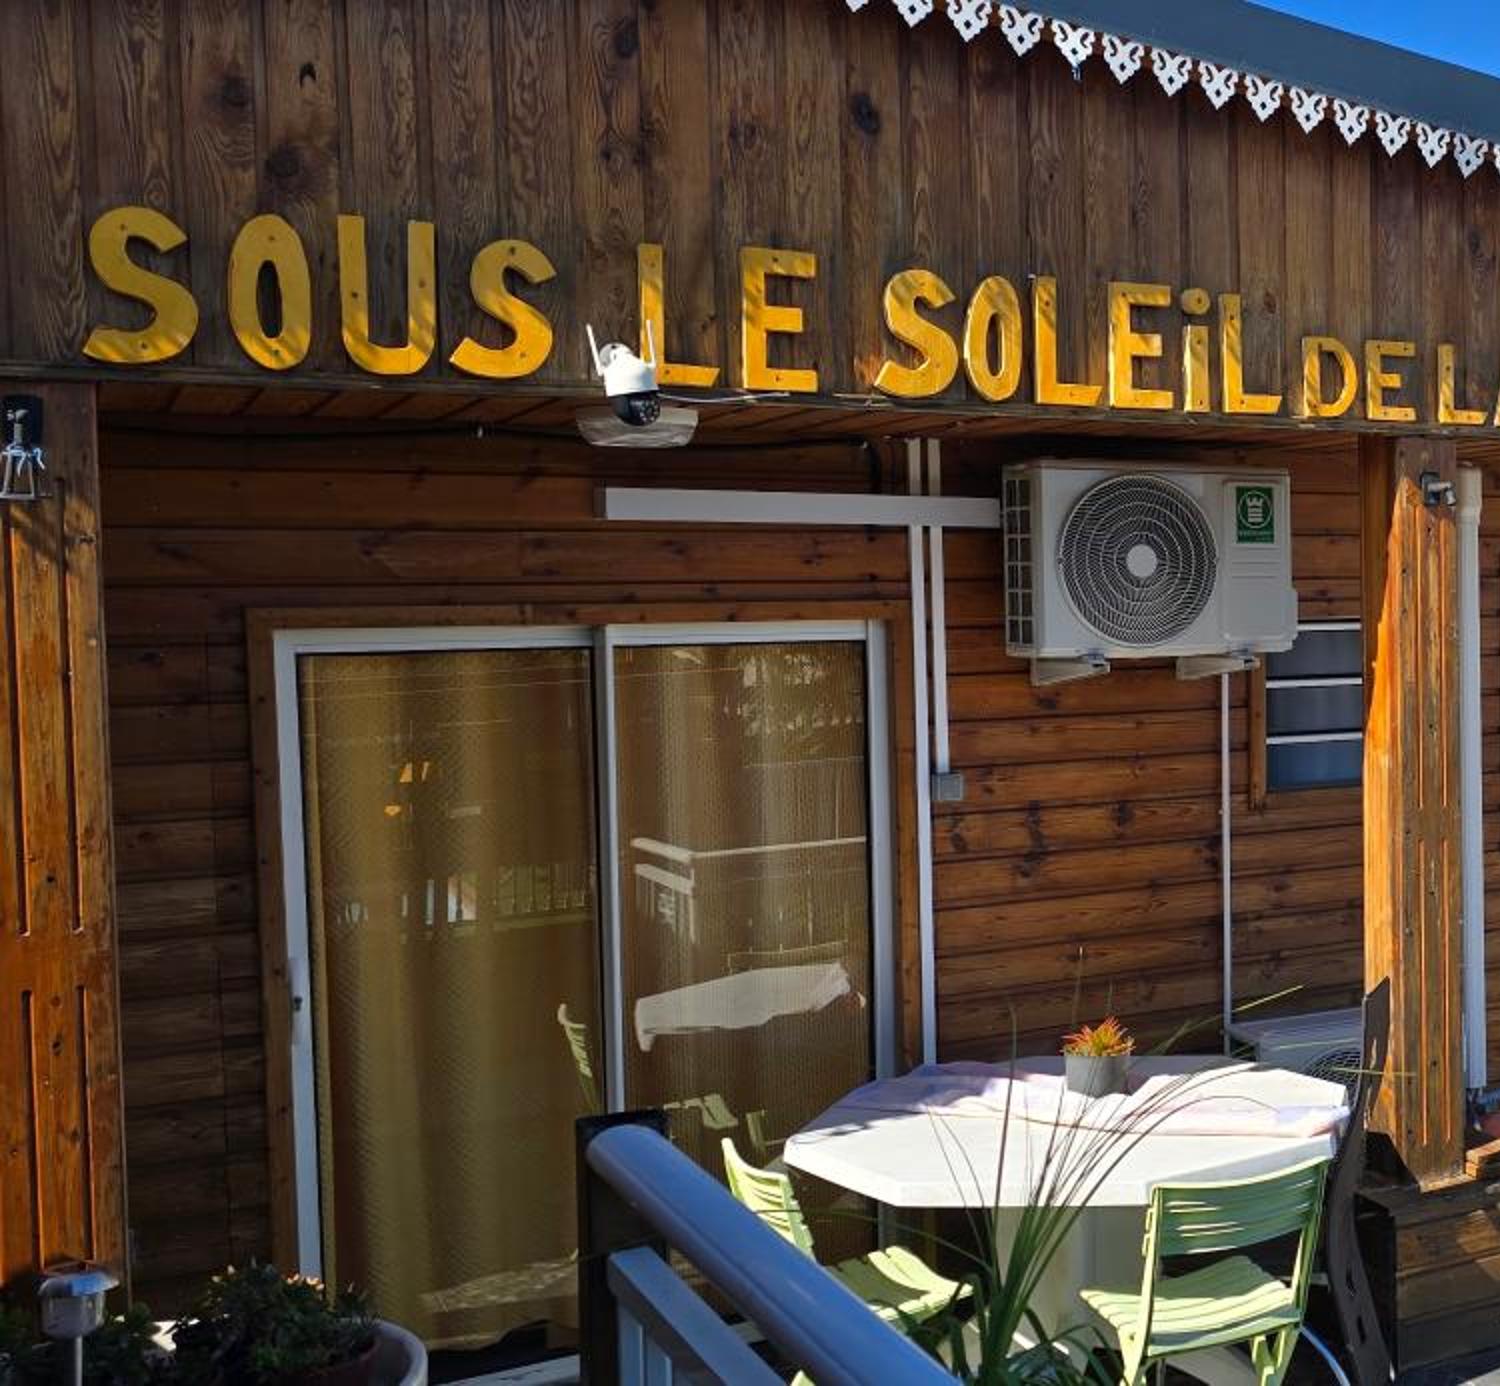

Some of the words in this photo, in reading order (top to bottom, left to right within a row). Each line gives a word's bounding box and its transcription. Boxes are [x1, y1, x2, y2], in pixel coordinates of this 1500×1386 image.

[83, 206, 556, 378] SOUS
[638, 243, 818, 392] LE
[1302, 337, 1416, 421] DE
